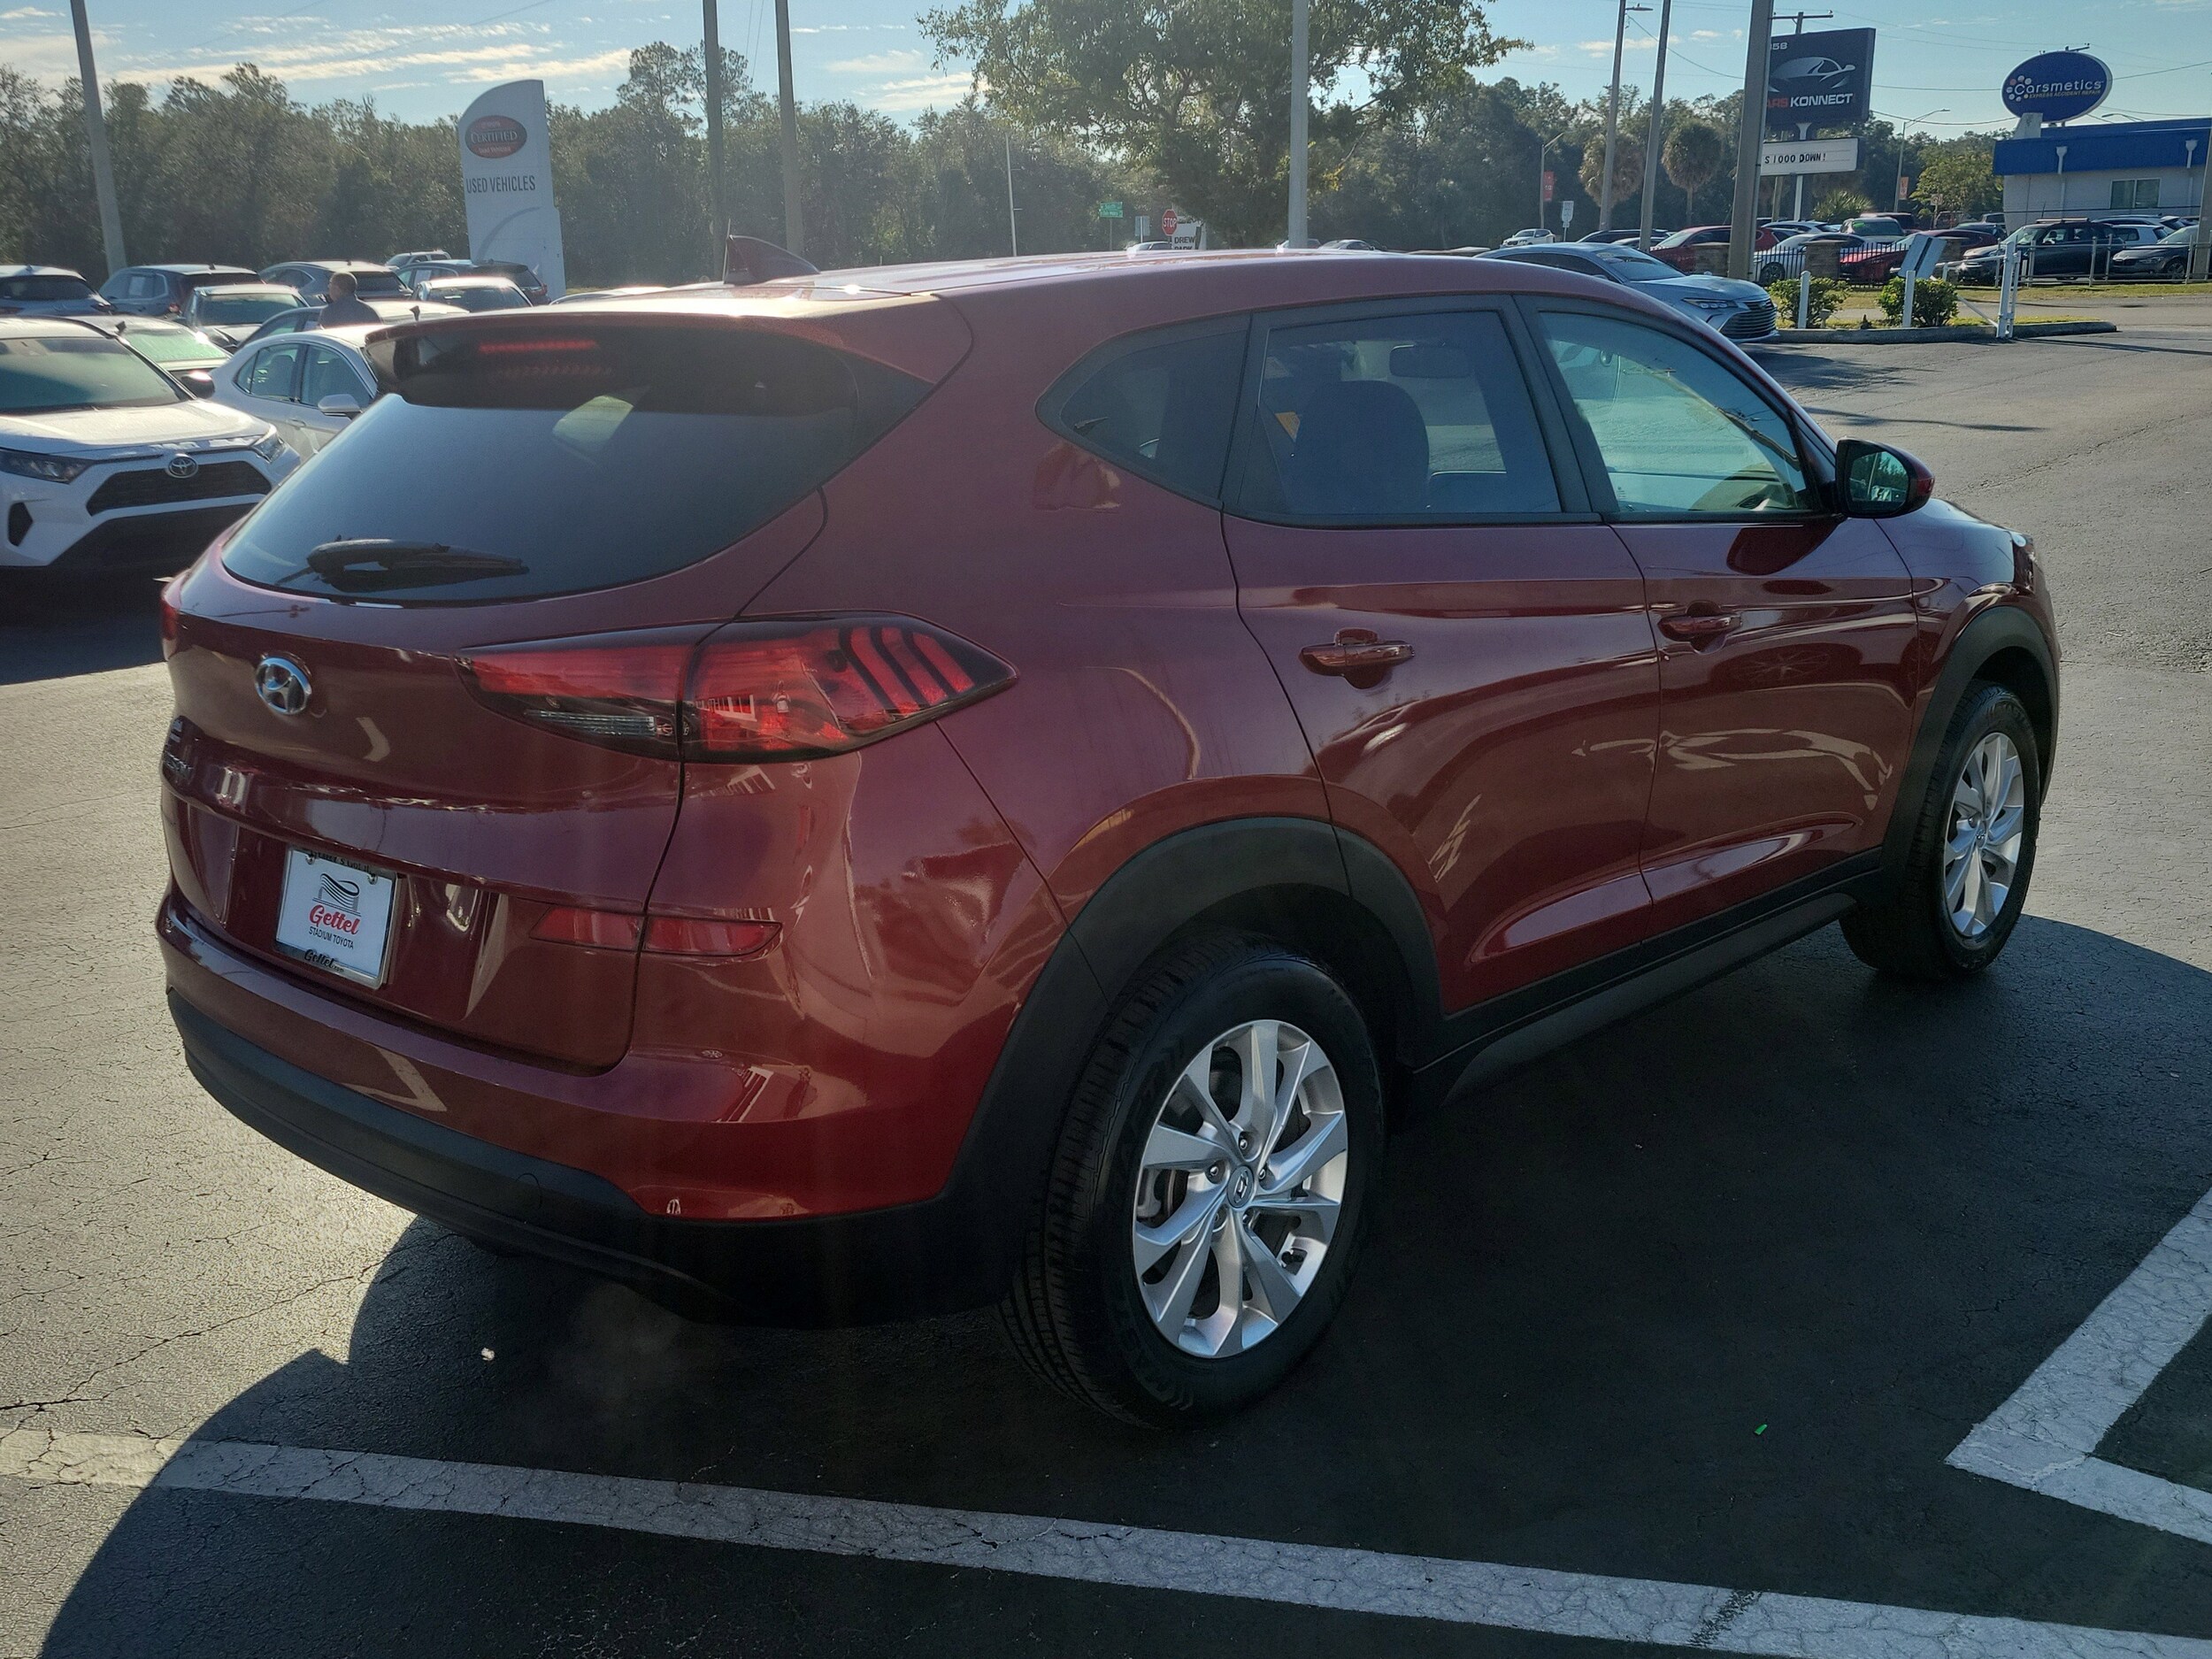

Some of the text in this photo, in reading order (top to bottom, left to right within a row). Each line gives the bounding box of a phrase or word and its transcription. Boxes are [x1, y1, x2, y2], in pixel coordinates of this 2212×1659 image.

[2014, 80, 2102, 95] Carsmetics
[1767, 93, 1854, 108] ARS KONNECT
[465, 174, 536, 194] USED VEHICLES
[1164, 218, 1177, 227] STOP
[310, 904, 361, 934] Gettel
[308, 926, 354, 949] STADIUM TOYOTA
